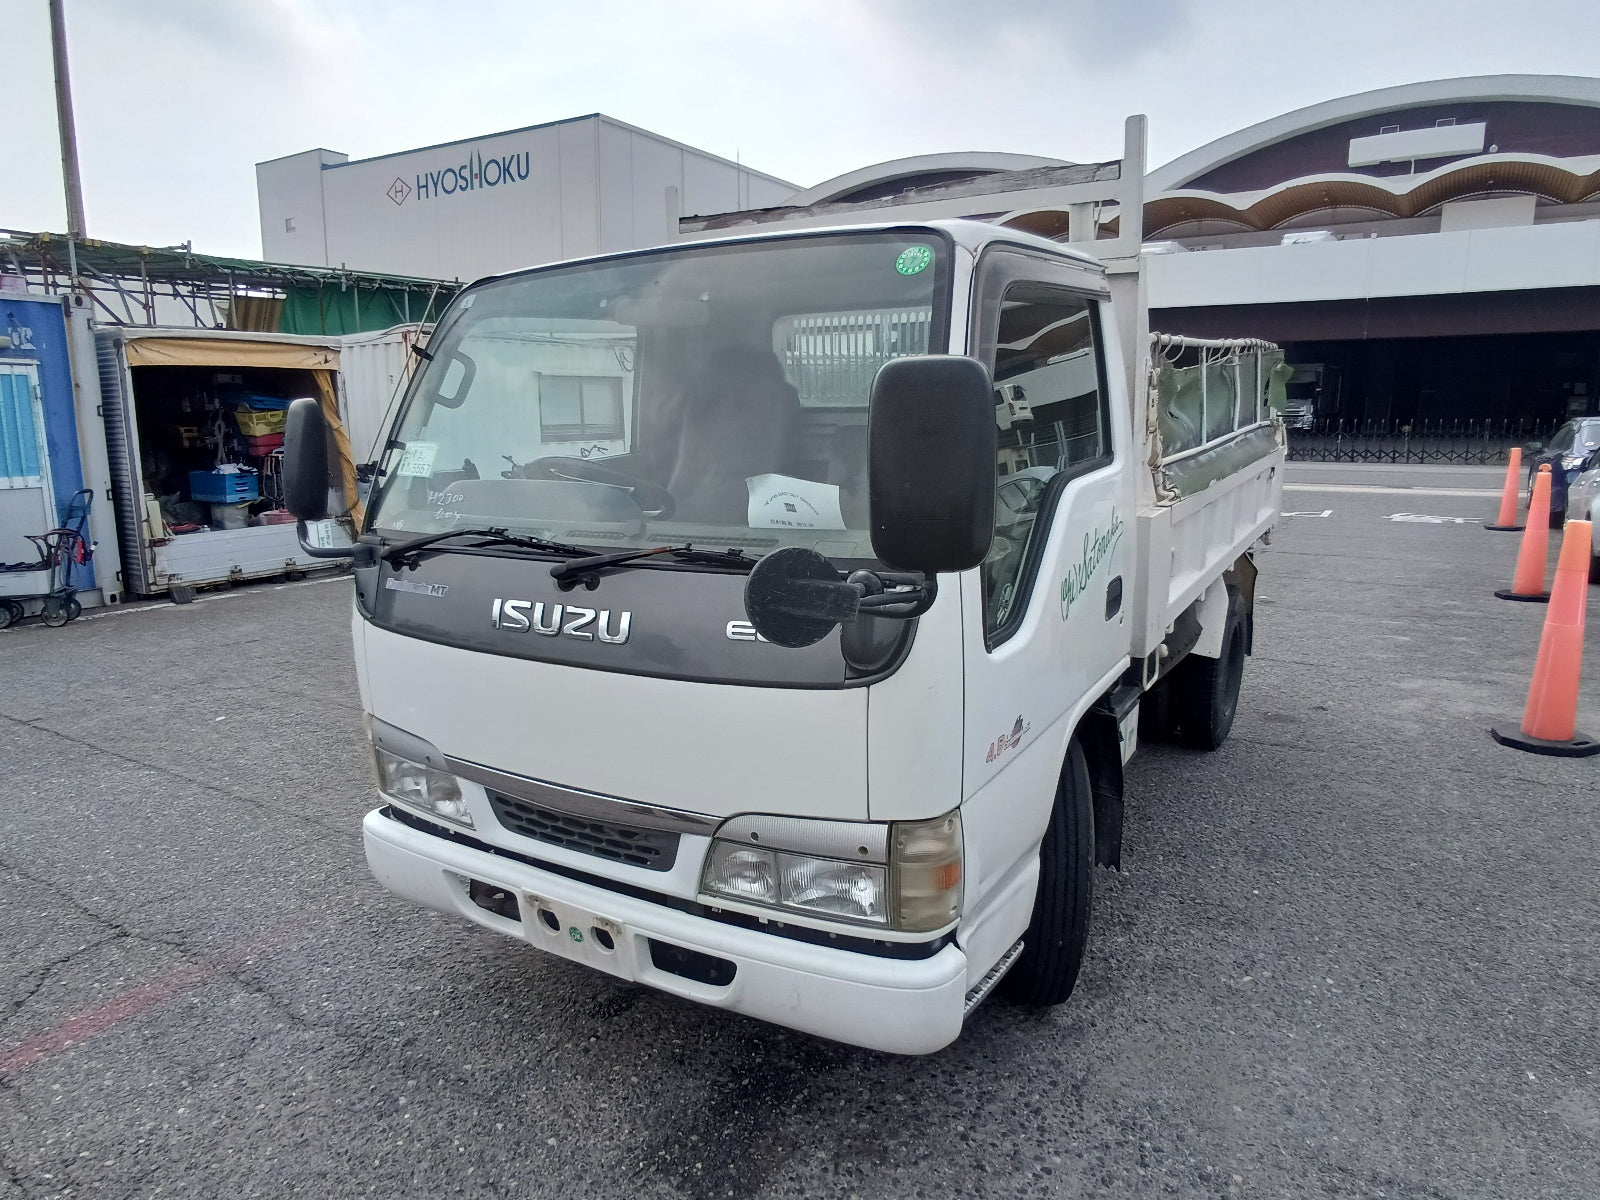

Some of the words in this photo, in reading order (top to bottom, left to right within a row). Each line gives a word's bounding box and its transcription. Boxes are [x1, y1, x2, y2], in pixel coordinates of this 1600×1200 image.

[416, 149, 530, 201] HYOSHOKU
[430, 584, 448, 597] MT
[492, 598, 632, 645] ISUZU
